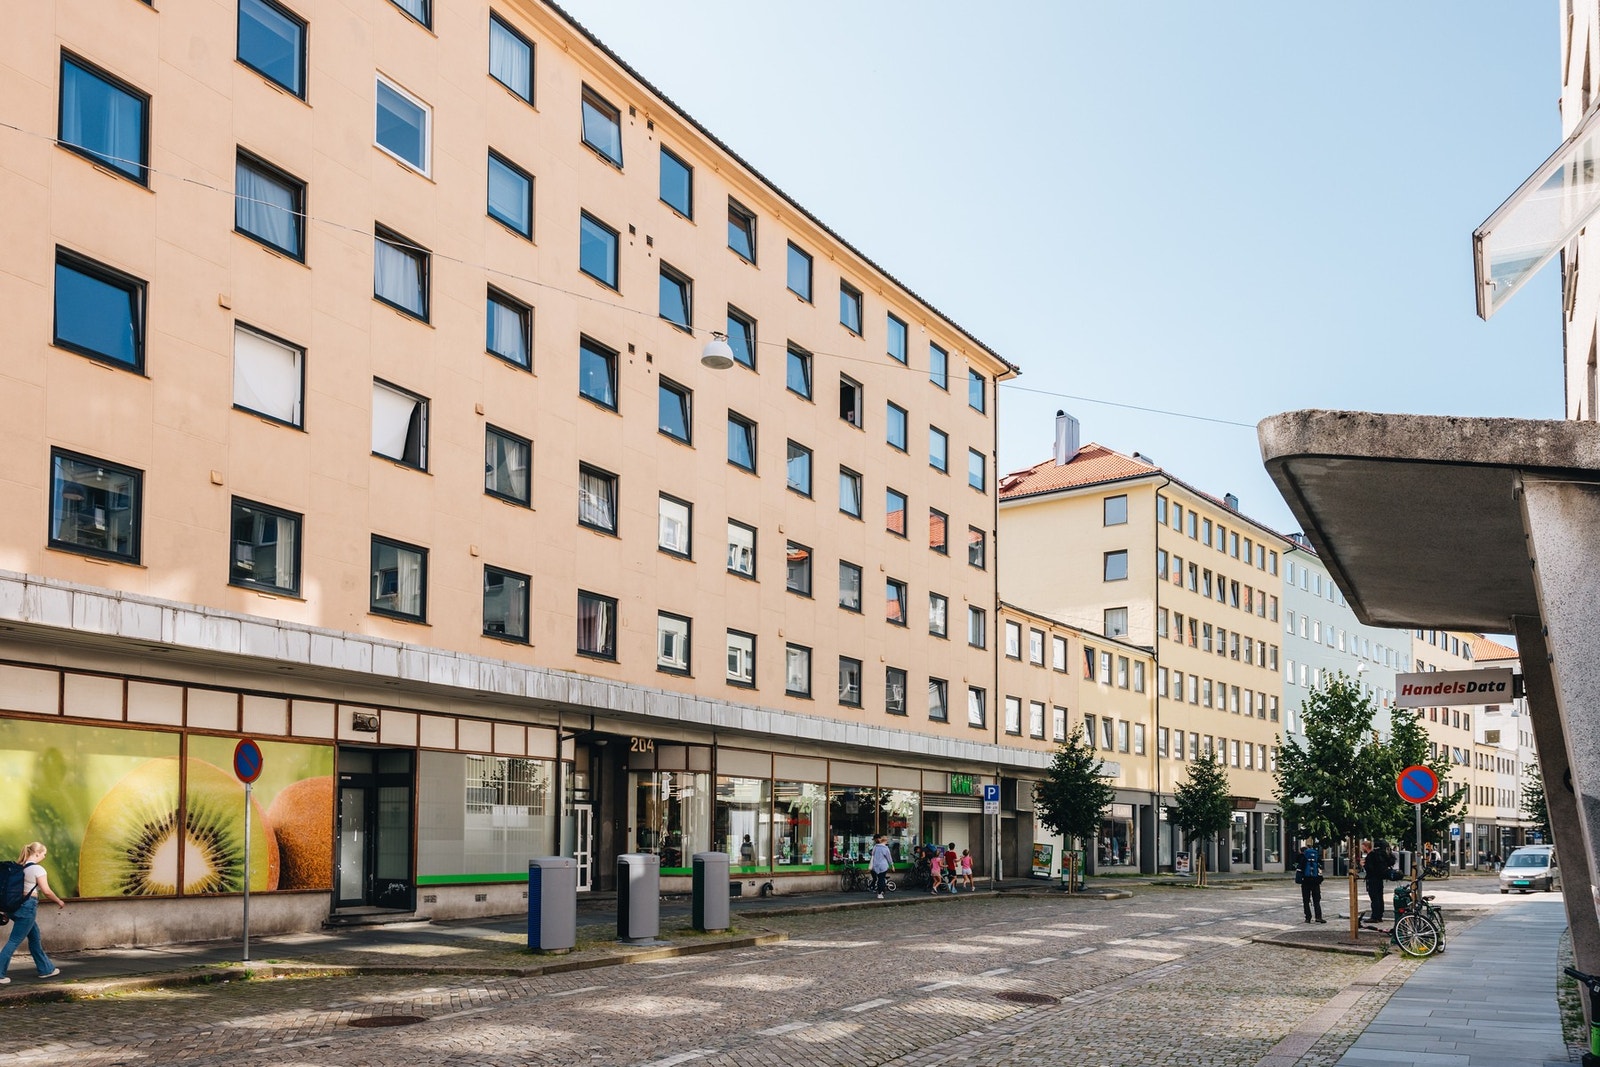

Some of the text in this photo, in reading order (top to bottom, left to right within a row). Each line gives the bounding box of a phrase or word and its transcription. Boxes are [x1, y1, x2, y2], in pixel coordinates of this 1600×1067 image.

[1402, 681, 1506, 696] HandelsData
[630, 736, 655, 753] 204
[988, 787, 996, 800] P
